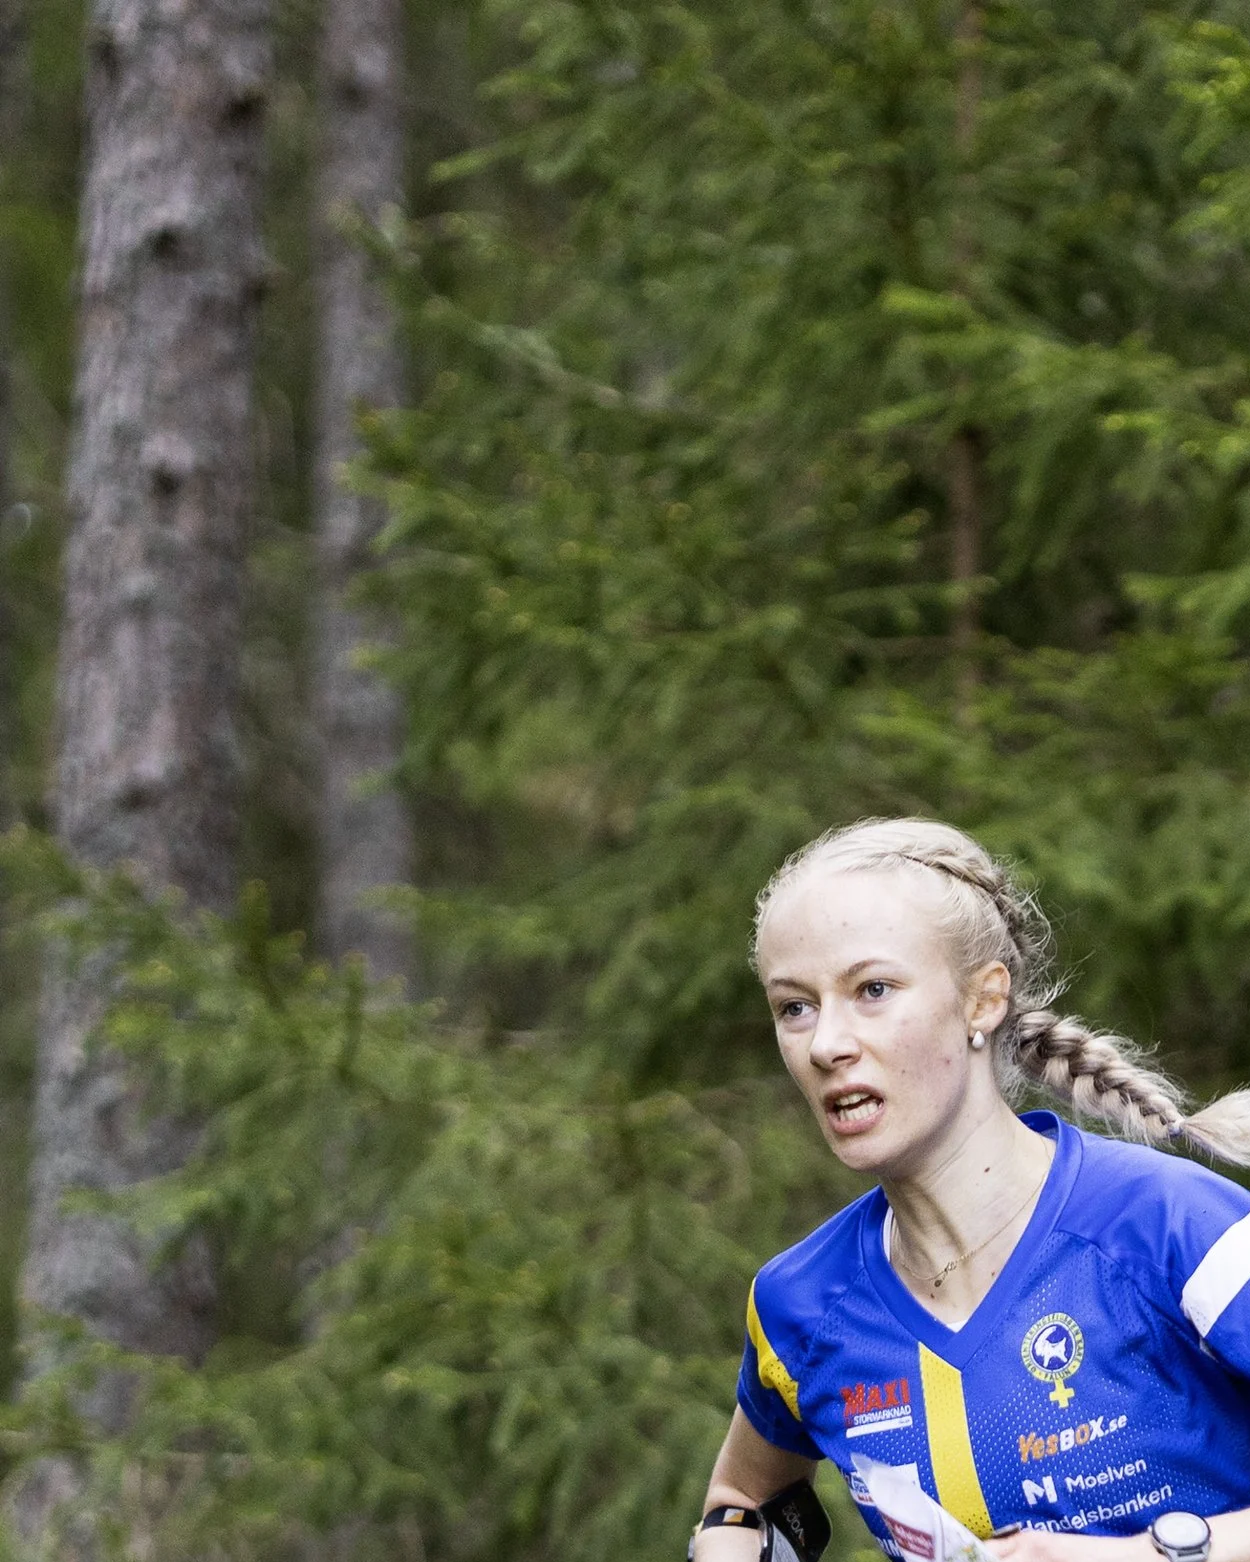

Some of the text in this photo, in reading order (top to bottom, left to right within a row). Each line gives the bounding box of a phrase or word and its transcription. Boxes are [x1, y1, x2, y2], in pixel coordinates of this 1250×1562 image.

[840, 1377, 910, 1417] MAXI
[853, 1404, 912, 1426] STORMARKNAD
[1065, 1458, 1147, 1493] Moelven
